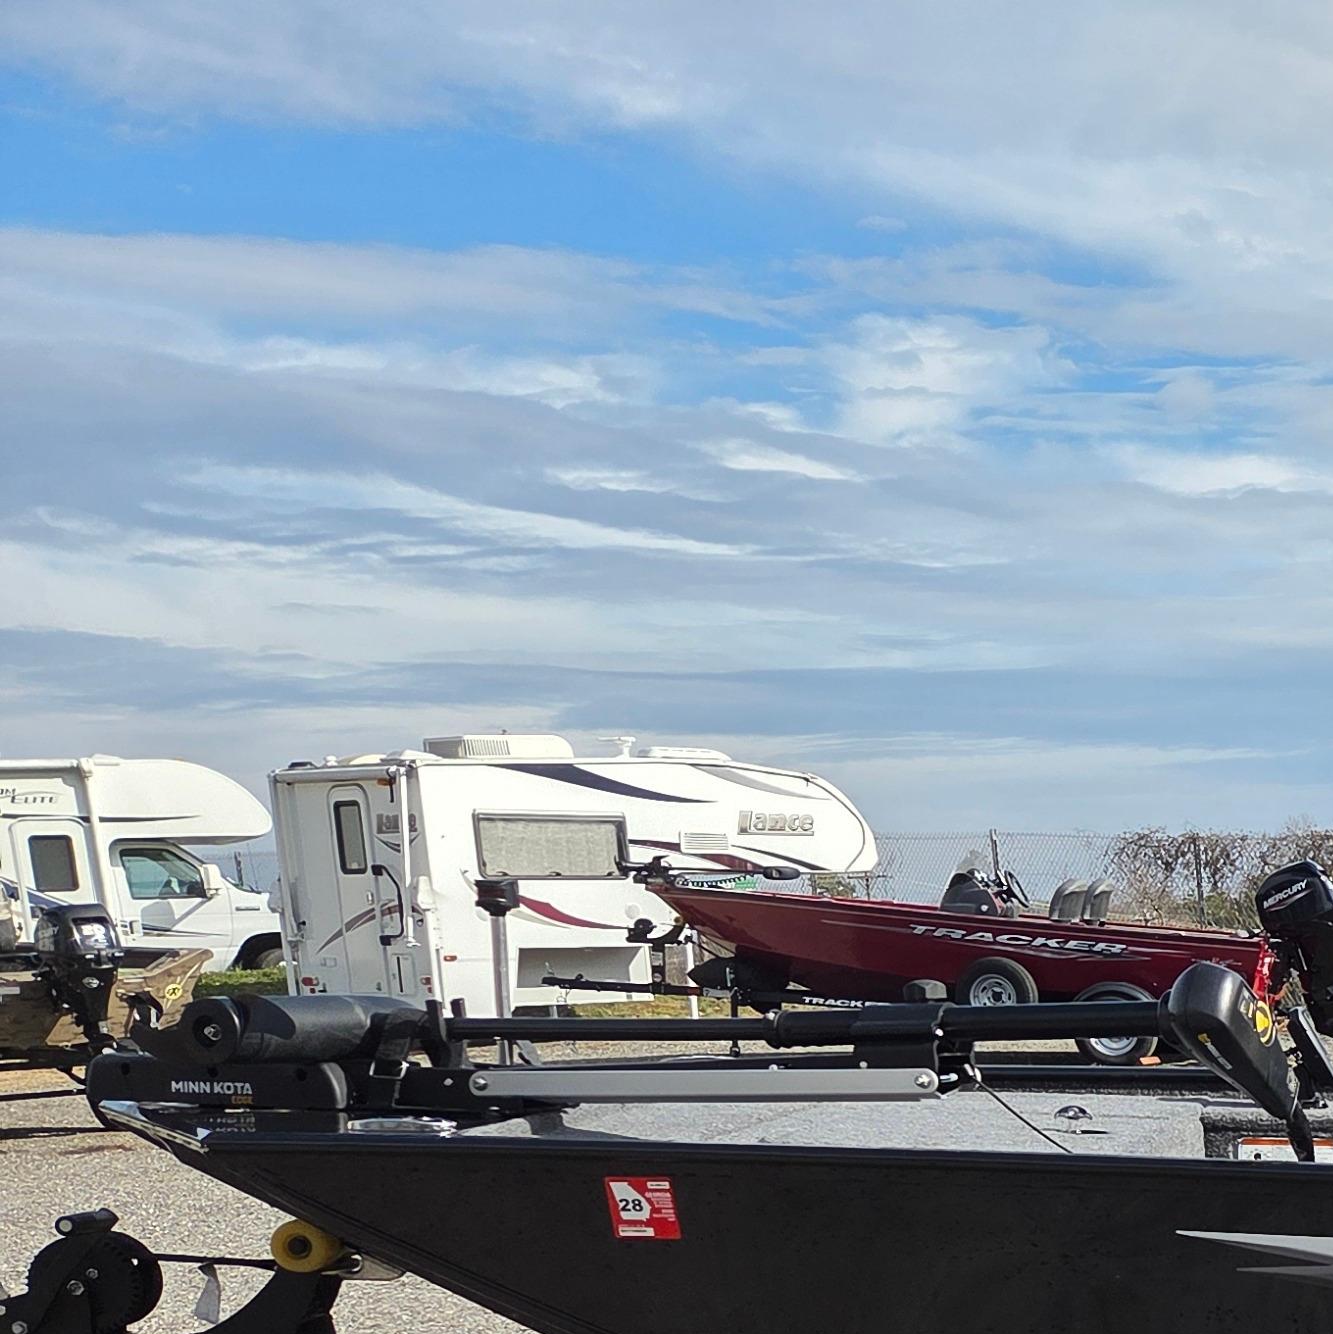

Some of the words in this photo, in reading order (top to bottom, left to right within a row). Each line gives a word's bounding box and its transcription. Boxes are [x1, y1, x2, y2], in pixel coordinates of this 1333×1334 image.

[737, 810, 814, 836] Lance
[1263, 879, 1308, 910] MERCURY
[909, 924, 1127, 954] TRACKER
[171, 1080, 210, 1094] MINN
[213, 1082, 253, 1095] KOTA
[619, 1198, 643, 1212] 28
